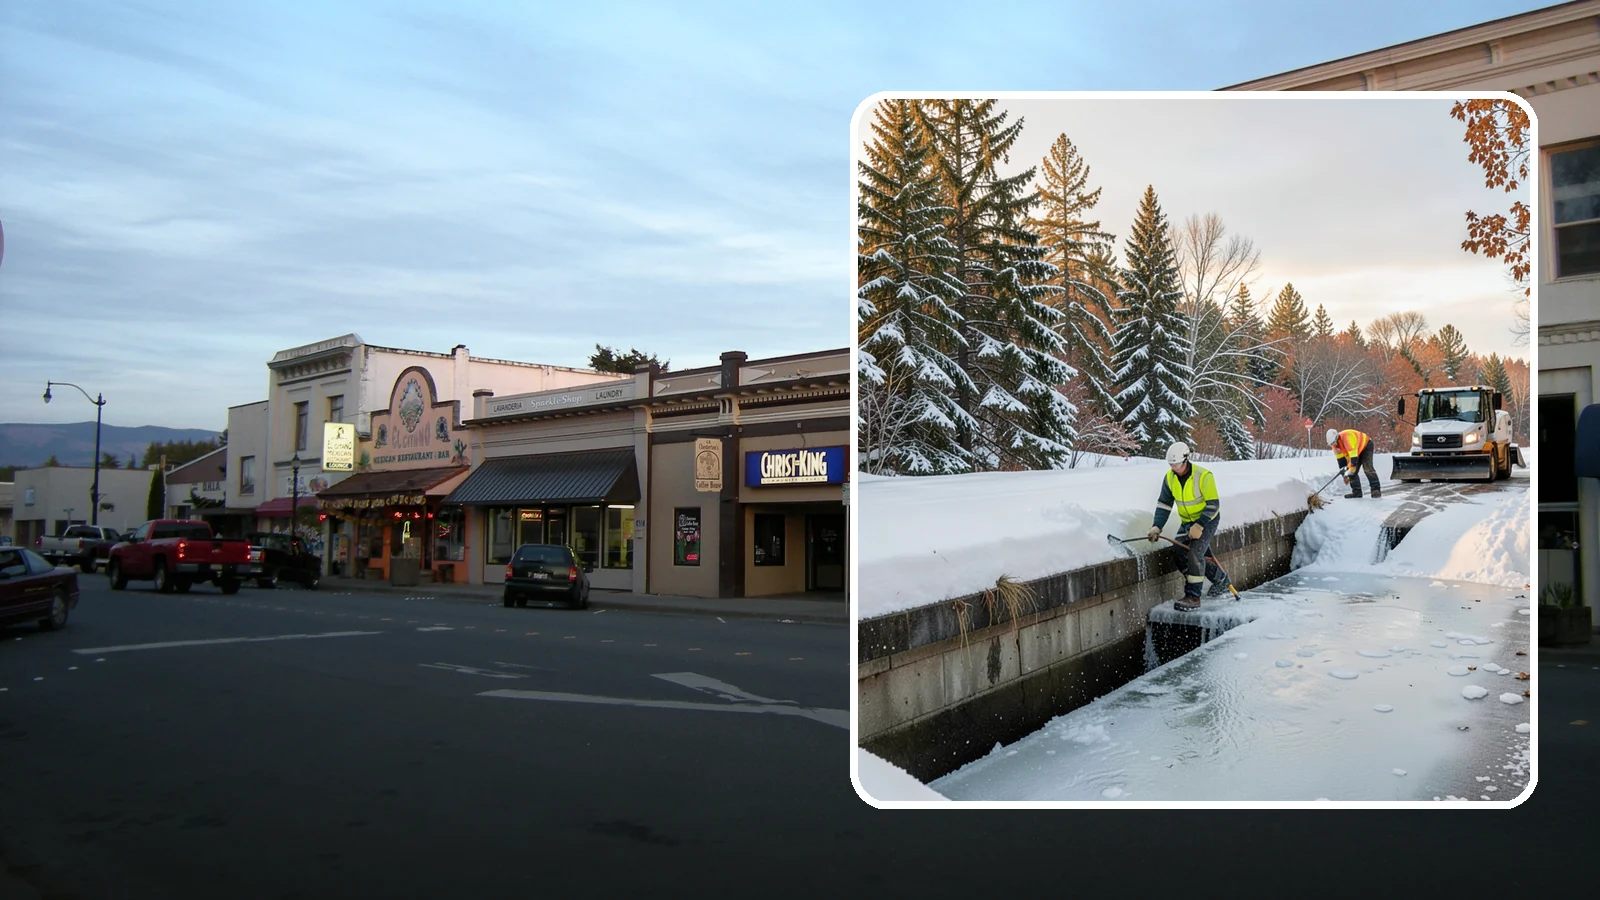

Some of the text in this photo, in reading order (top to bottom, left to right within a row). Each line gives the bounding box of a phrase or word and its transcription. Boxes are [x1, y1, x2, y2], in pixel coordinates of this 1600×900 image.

[595, 389, 623, 400] LAUNDRY
[493, 402, 522, 413] LAVANDERIA
[531, 394, 583, 409] Sparkle Shop
[374, 454, 396, 464] MEXICAN
[397, 451, 433, 462] RESTAURANT
[438, 450, 450, 459] BAR
[761, 450, 827, 477] CHRIST KING
[696, 480, 722, 489] Coffee House
